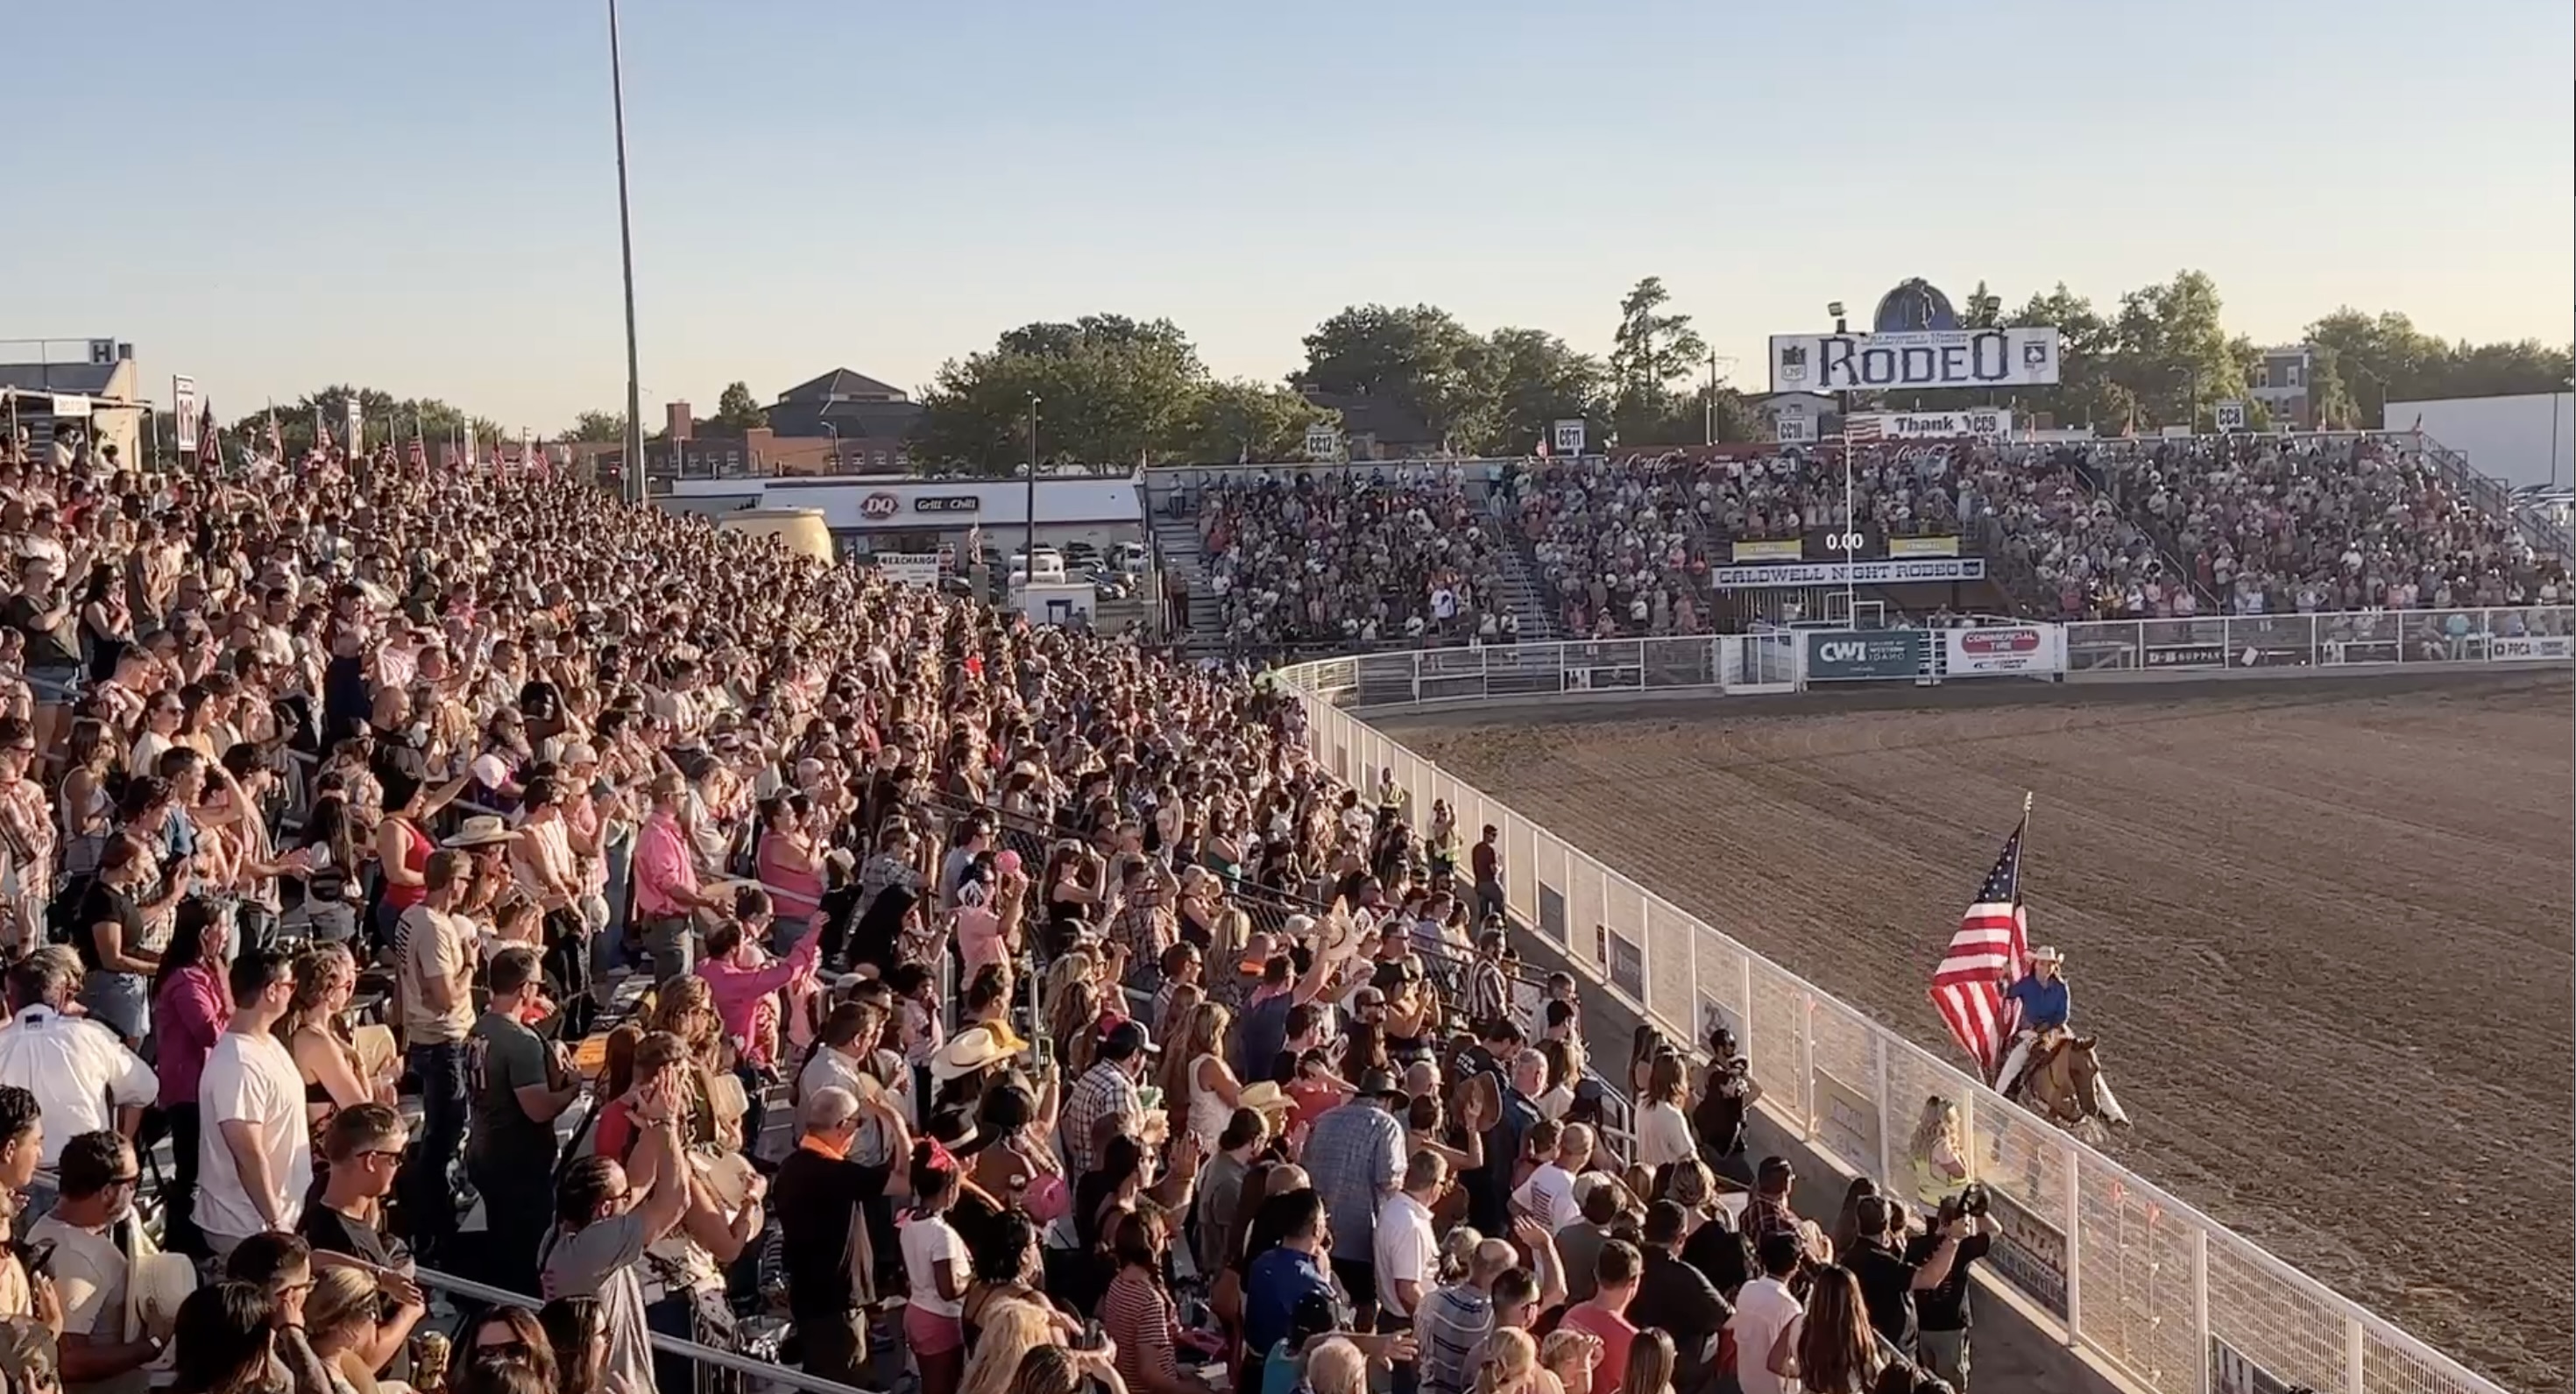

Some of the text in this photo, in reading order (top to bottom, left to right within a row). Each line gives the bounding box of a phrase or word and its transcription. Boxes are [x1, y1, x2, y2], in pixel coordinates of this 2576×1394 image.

[93, 344, 111, 363] H
[1818, 332, 2008, 387] RODEO
[1894, 415, 1953, 433] Thank
[1974, 415, 1996, 432] CC9
[2219, 408, 2240, 425] CC8
[1560, 429, 1580, 446] CC11
[867, 497, 895, 513] DQ
[917, 499, 976, 510] Grill Chill
[1827, 533, 1865, 549] 0.00
[1719, 566, 1825, 584] CALDWELL
[1831, 565, 1890, 580] NGHT
[1896, 562, 1959, 577] RODEO
[1820, 640, 1866, 663] CWI
[1991, 640, 2012, 651] TIRE
[1869, 653, 1905, 662] IDAHO
